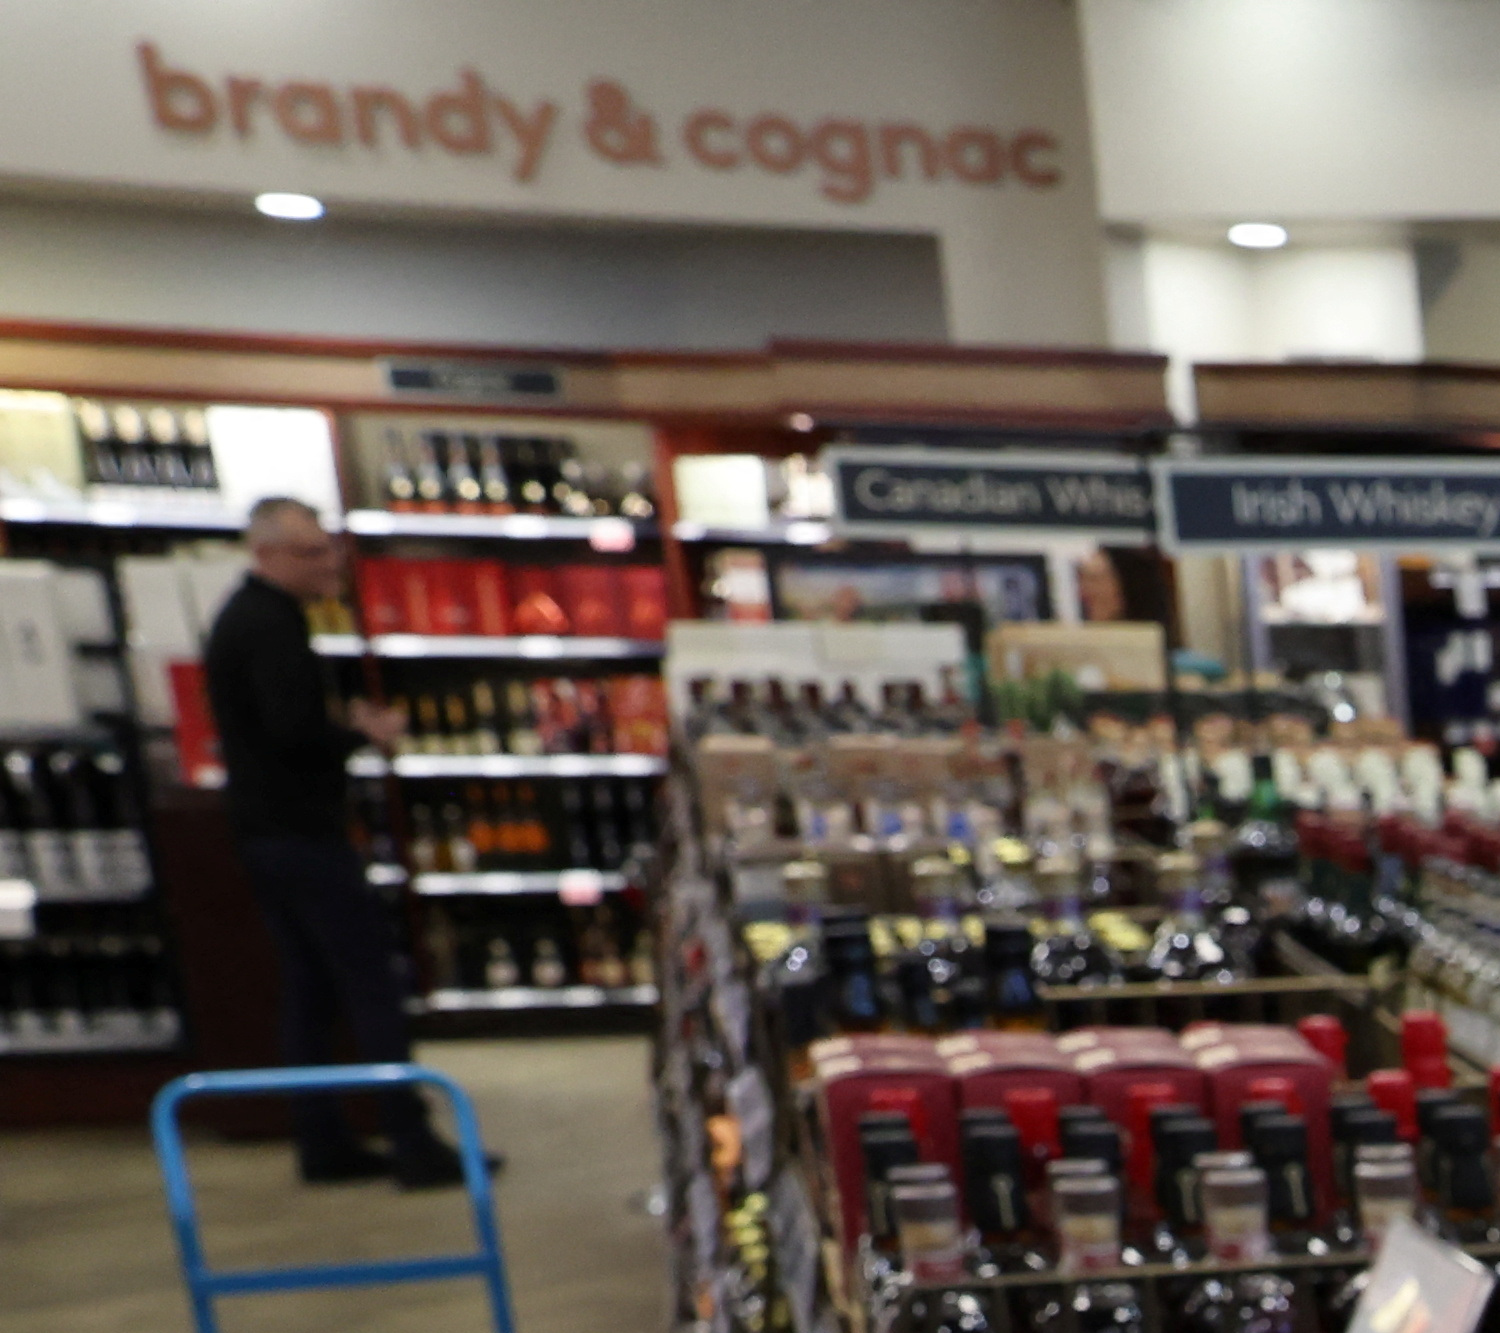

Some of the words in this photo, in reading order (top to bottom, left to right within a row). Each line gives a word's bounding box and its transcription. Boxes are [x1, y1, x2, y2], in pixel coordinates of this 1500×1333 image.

[139, 40, 560, 182] brandy
[585, 82, 662, 165] &
[684, 105, 1063, 200] cognac
[853, 468, 1042, 516] Canadian
[1043, 473, 1152, 518] Whis
[1230, 480, 1321, 526] Irish
